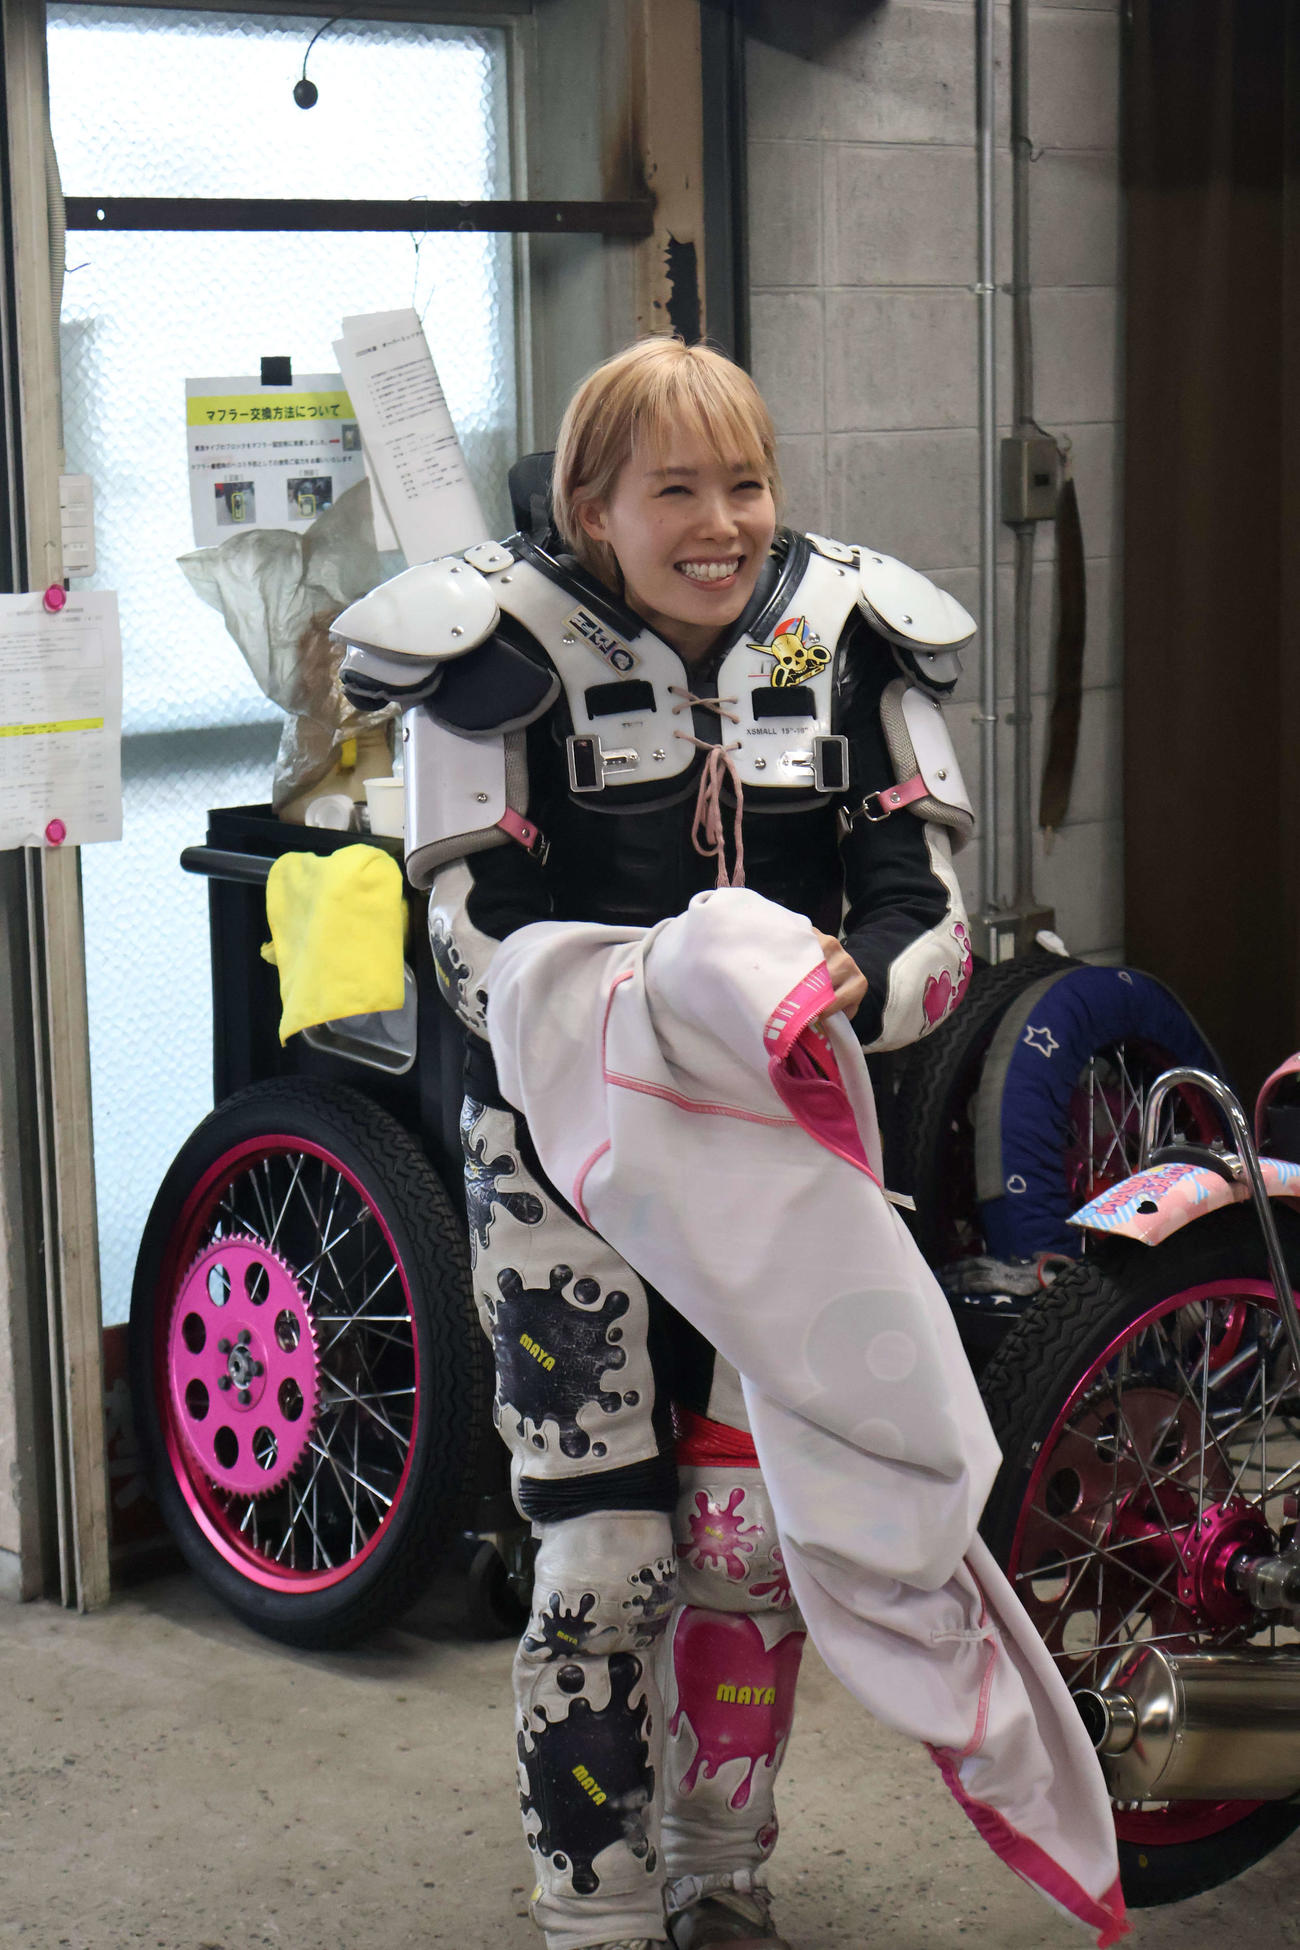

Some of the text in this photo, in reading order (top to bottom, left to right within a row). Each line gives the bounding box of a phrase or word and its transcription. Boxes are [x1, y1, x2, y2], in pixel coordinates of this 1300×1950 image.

[206, 404, 340, 421] マフラー交換方法について
[519, 1333, 556, 1372] MAYA
[716, 1684, 776, 1706] MAYA
[571, 1765, 607, 1807] MAYA
